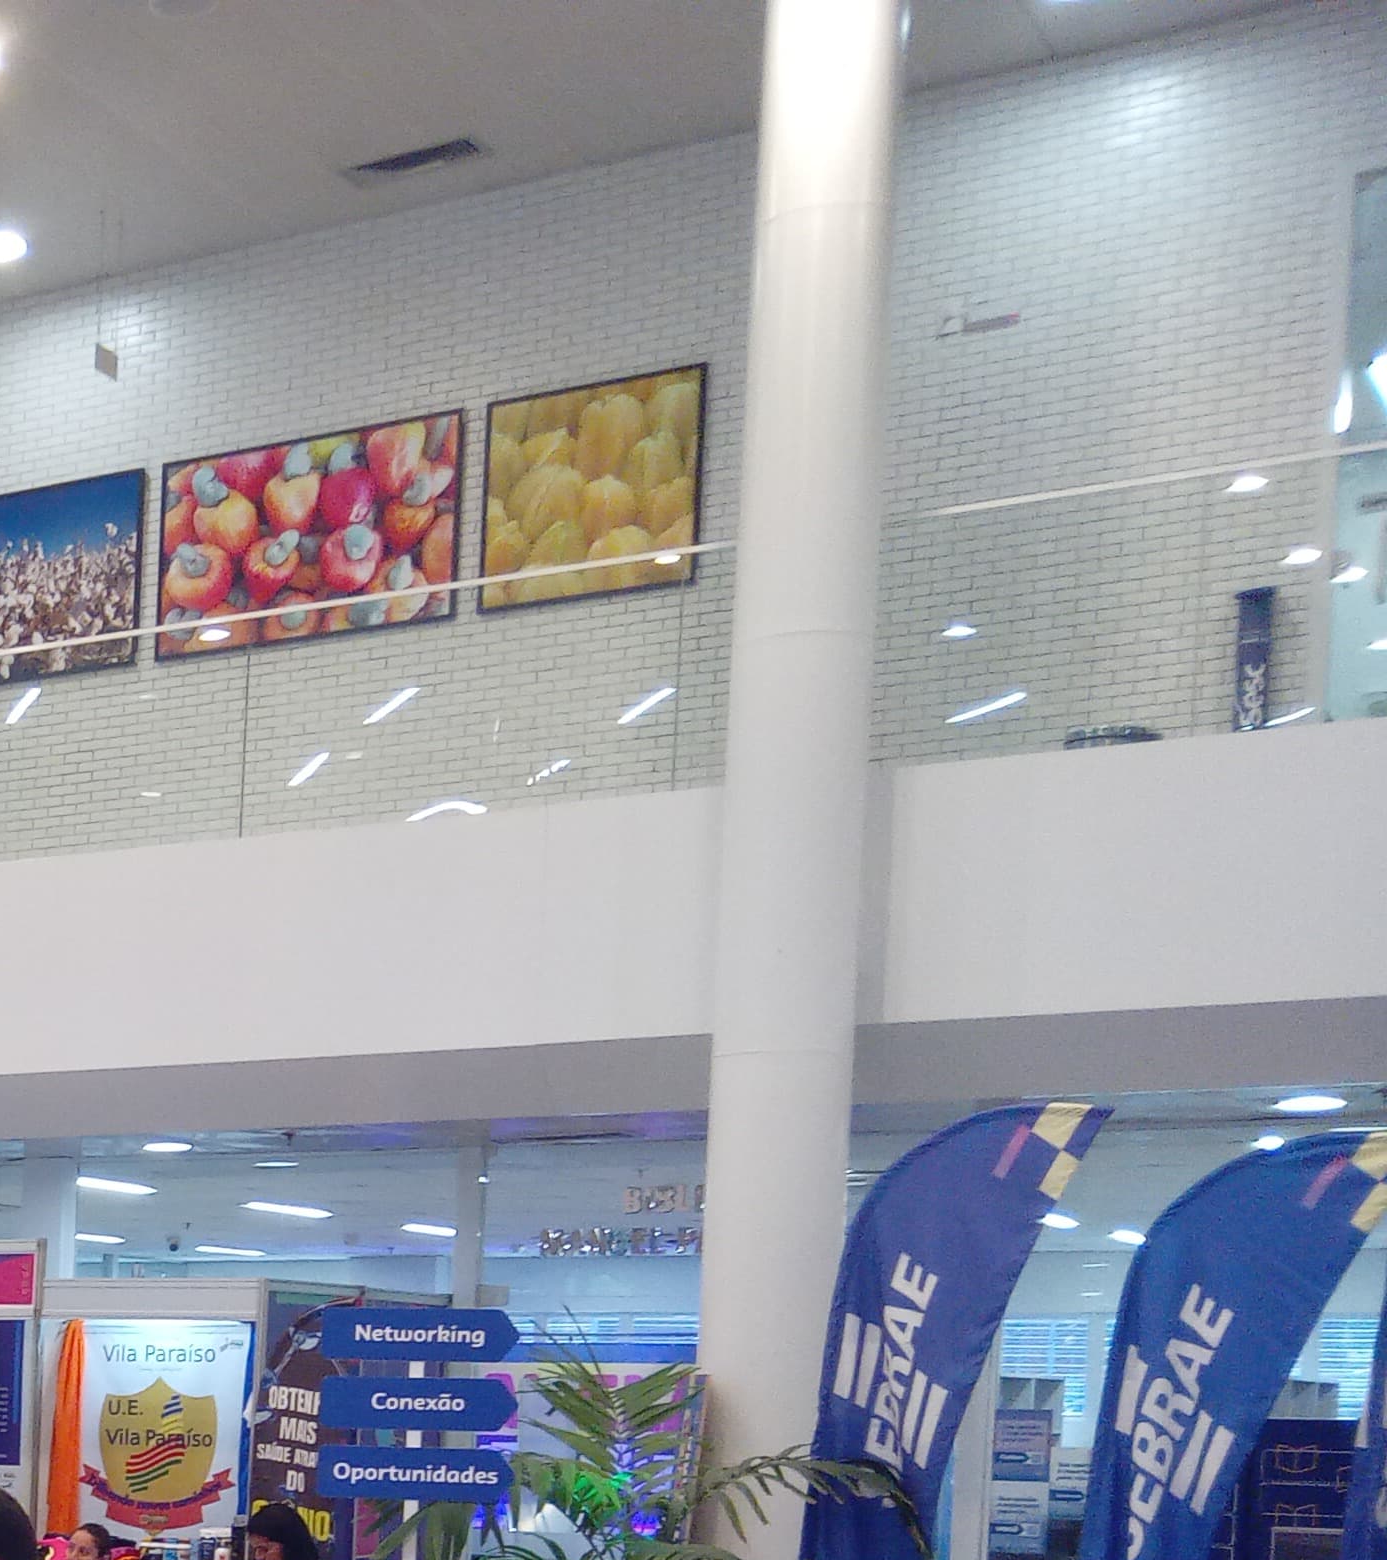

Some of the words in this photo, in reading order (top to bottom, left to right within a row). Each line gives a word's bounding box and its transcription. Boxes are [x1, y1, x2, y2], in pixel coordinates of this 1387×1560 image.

[354, 1324, 486, 1348] Networking
[103, 1343, 137, 1362] Vila
[144, 1343, 217, 1363] Paraíso
[863, 1251, 939, 1480] EBRAE
[108, 1400, 144, 1416] U.E.
[268, 1385, 321, 1416] OBTEN
[370, 1392, 466, 1412] Conexão
[105, 1428, 141, 1446] Vila
[145, 1428, 213, 1447] Paraíso
[285, 1470, 305, 1494] DO
[332, 1462, 499, 1485] Oportunidades
